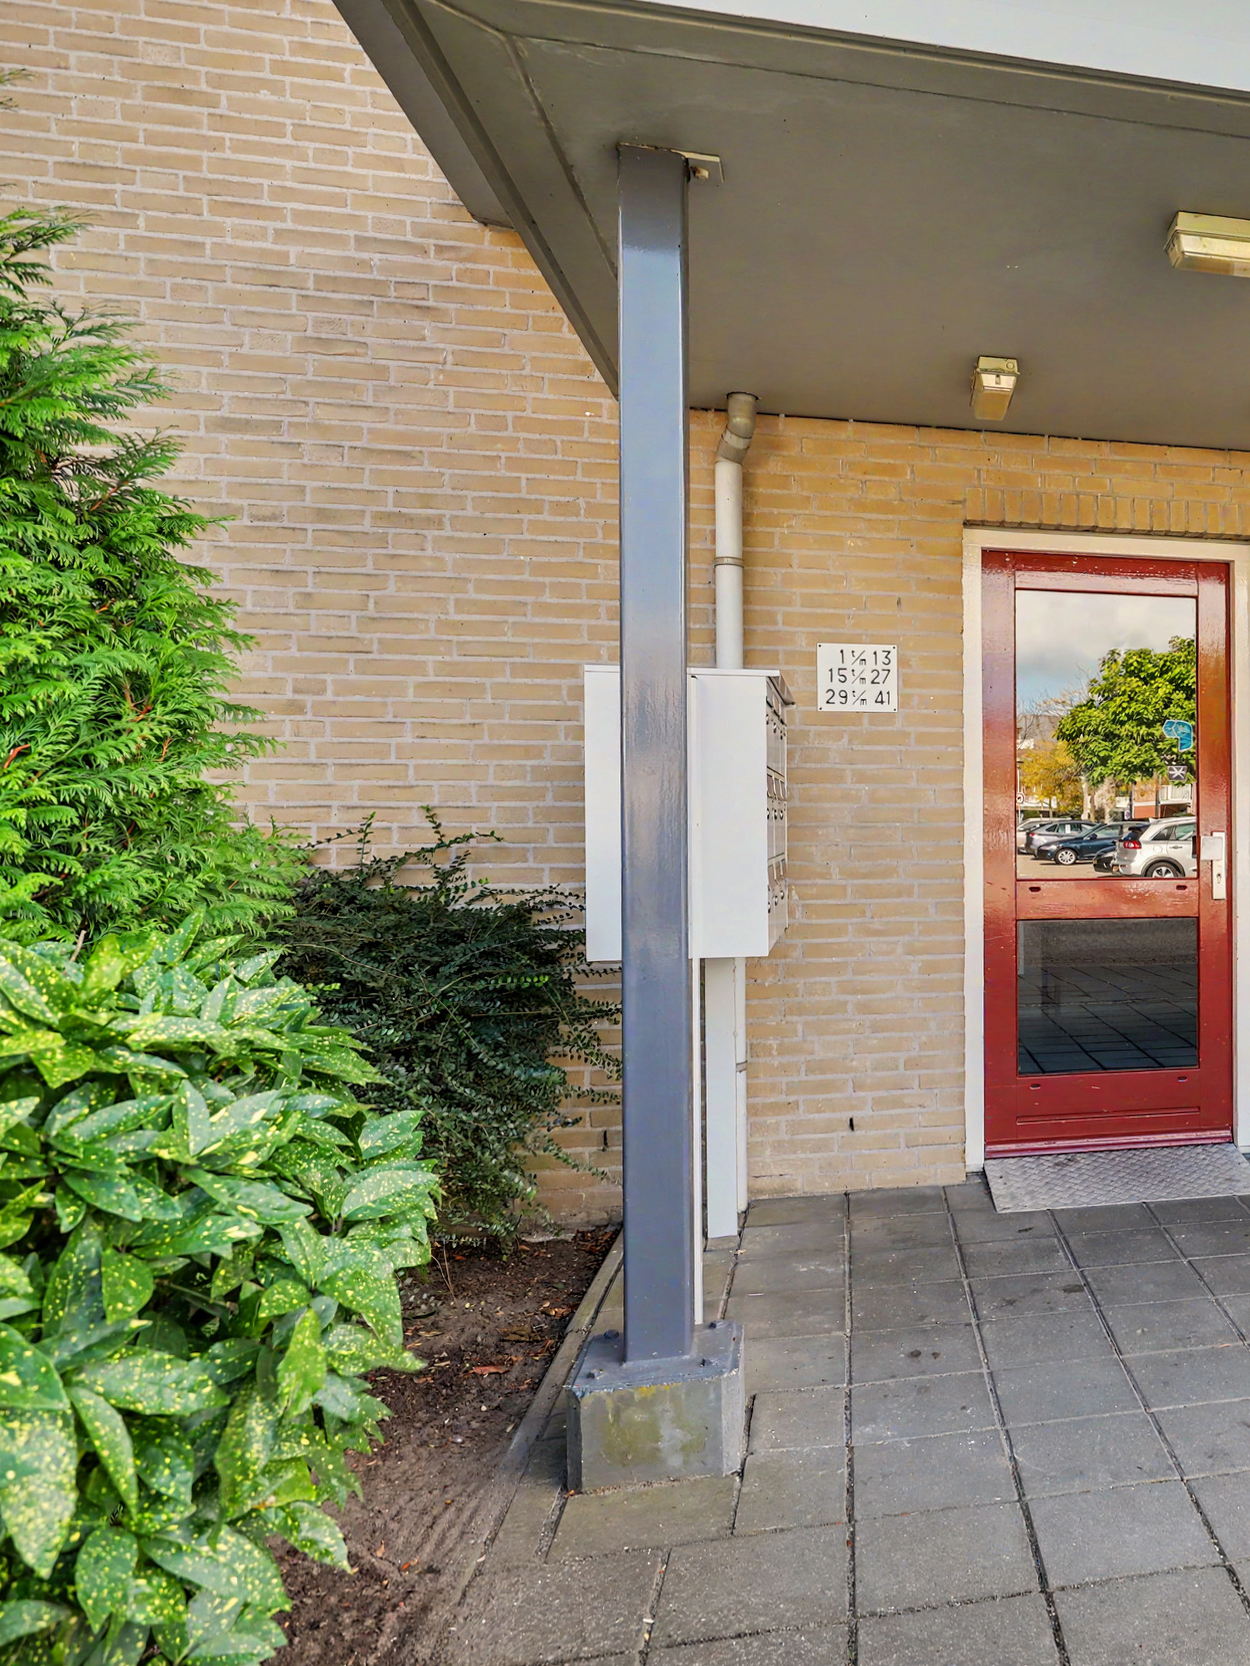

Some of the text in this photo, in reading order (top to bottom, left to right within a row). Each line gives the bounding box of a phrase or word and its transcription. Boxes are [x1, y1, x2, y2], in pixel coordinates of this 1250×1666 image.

[839, 649, 845, 664] 1
[873, 650, 891, 666] 13
[828, 668, 847, 683] 15
[870, 669, 891, 684] 27
[825, 689, 848, 704] 29
[874, 690, 890, 705] 41
